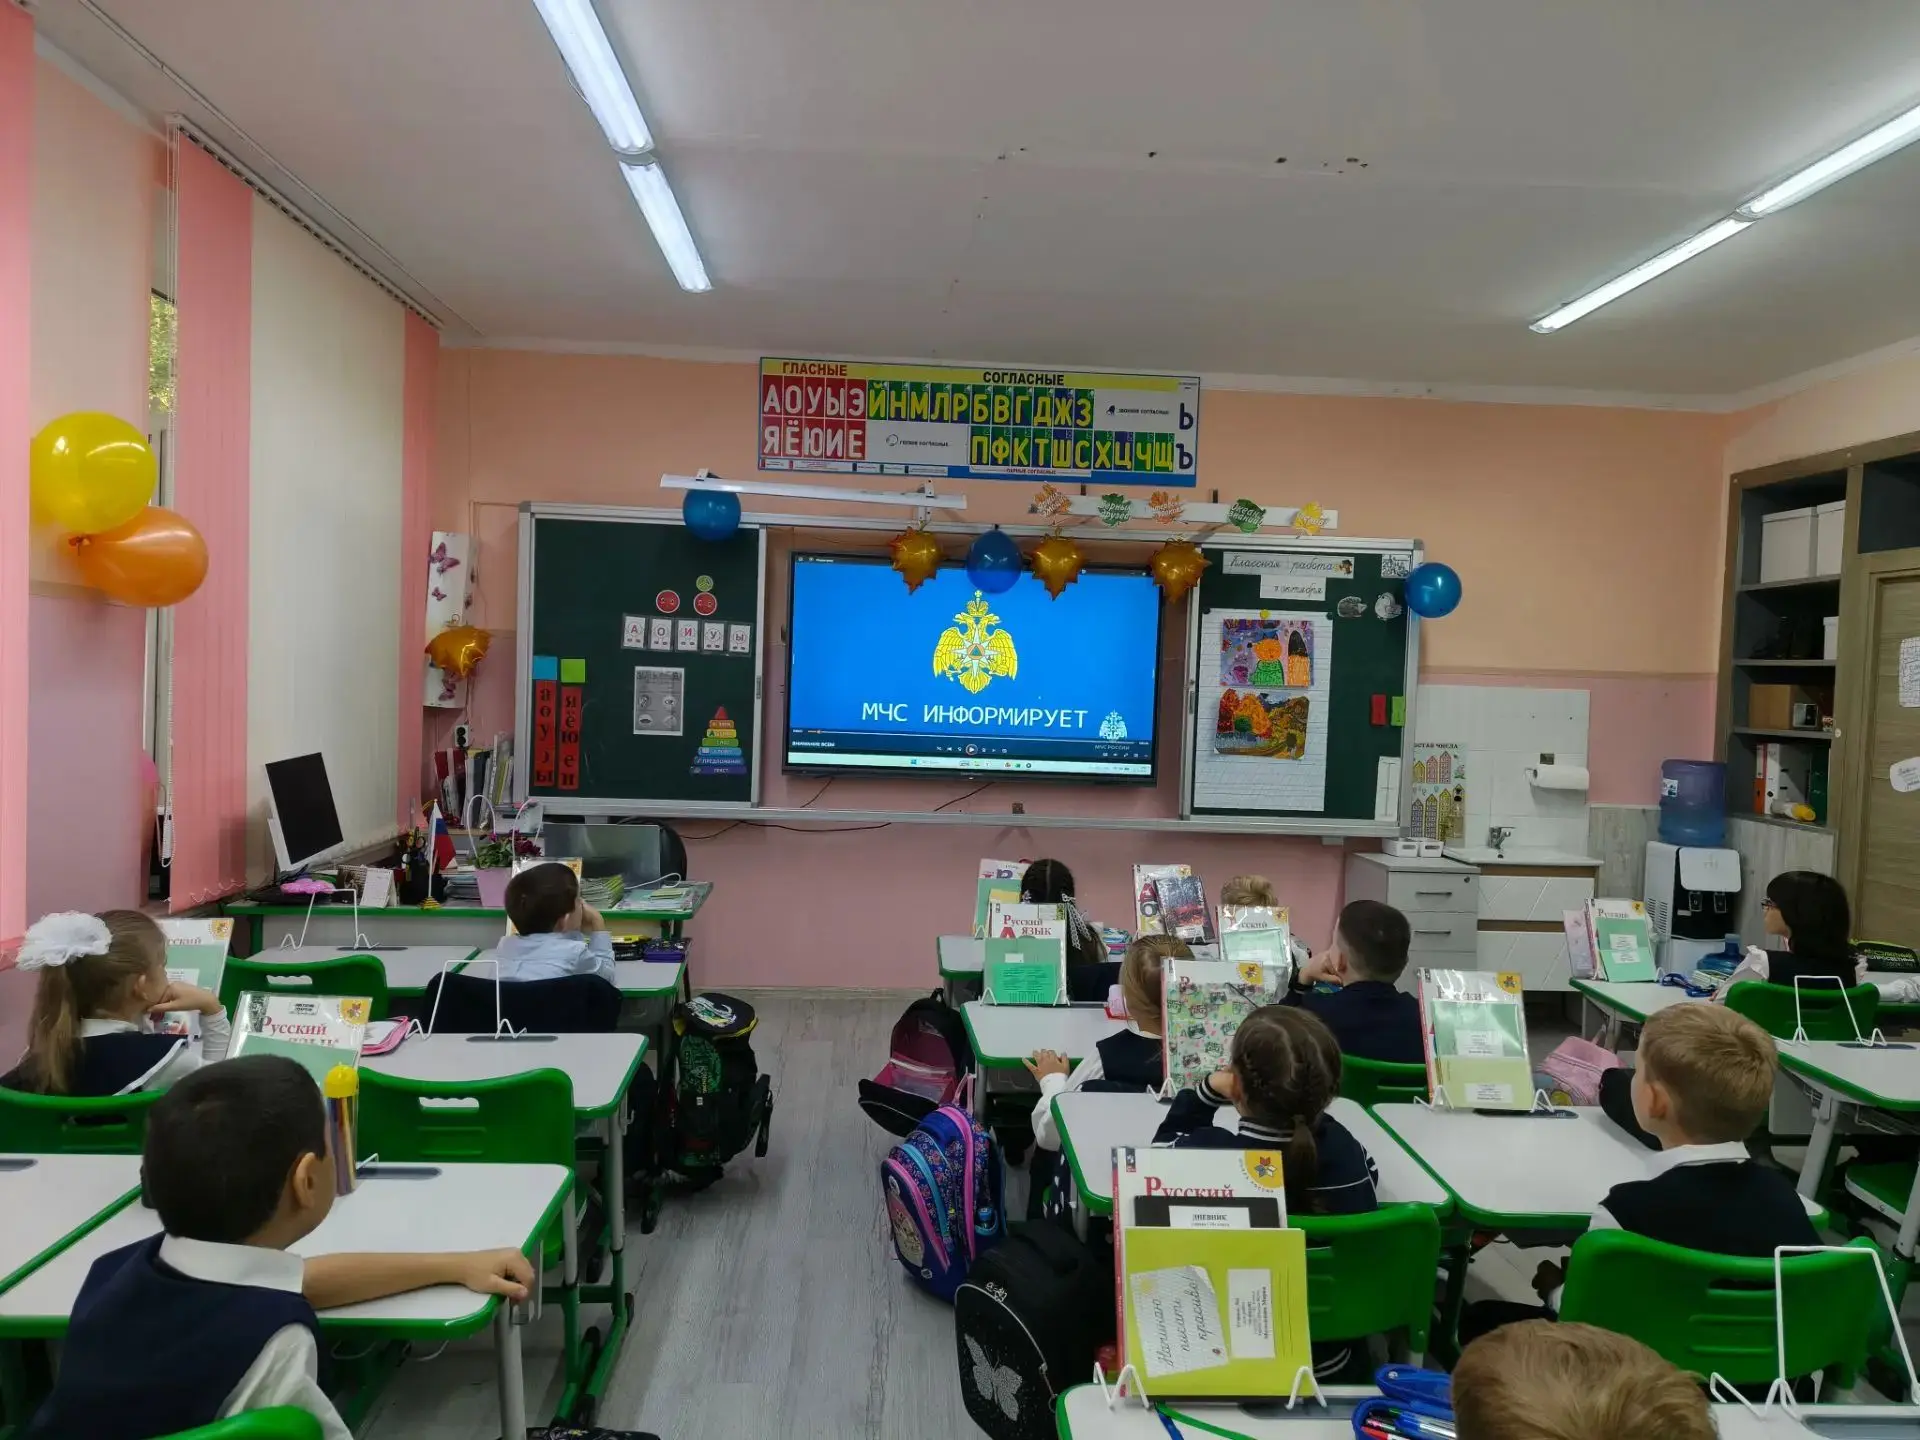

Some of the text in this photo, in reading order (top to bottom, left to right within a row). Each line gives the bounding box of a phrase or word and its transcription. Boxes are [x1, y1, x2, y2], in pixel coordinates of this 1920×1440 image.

[782, 361, 848, 377] ГЛАСНЫЕ
[983, 371, 1065, 386] СОГЛАСНЫЕ
[1230, 554, 1333, 574] Классная работа
[1281, 582, 1323, 598] октября
[630, 624, 638, 634] А
[657, 627, 666, 637] О
[684, 627, 692, 637] И
[710, 631, 717, 640] У
[862, 702, 1088, 729] МЧС ИНФОРМИРУЕТ
[1003, 914, 1043, 927] Русский
[262, 1015, 328, 1036] Русский
[1192, 1214, 1228, 1222] ДНЕВНИК
[1173, 1298, 1191, 1352] писать
